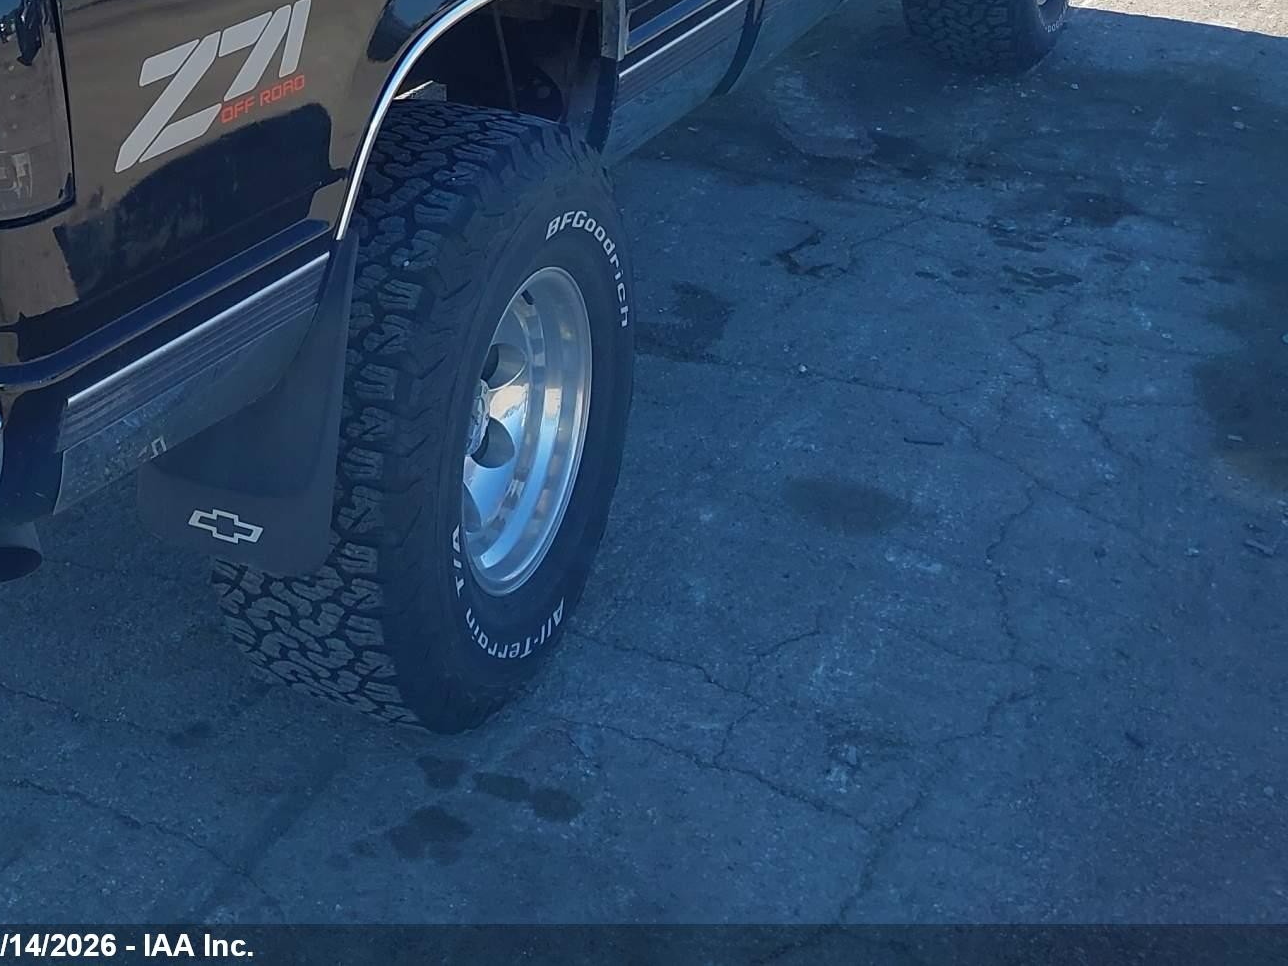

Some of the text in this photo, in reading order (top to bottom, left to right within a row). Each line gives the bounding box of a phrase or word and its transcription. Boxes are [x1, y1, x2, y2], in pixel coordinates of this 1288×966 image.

[220, 75, 305, 123] OFF ROAD
[545, 210, 629, 327] BFGoodrich
